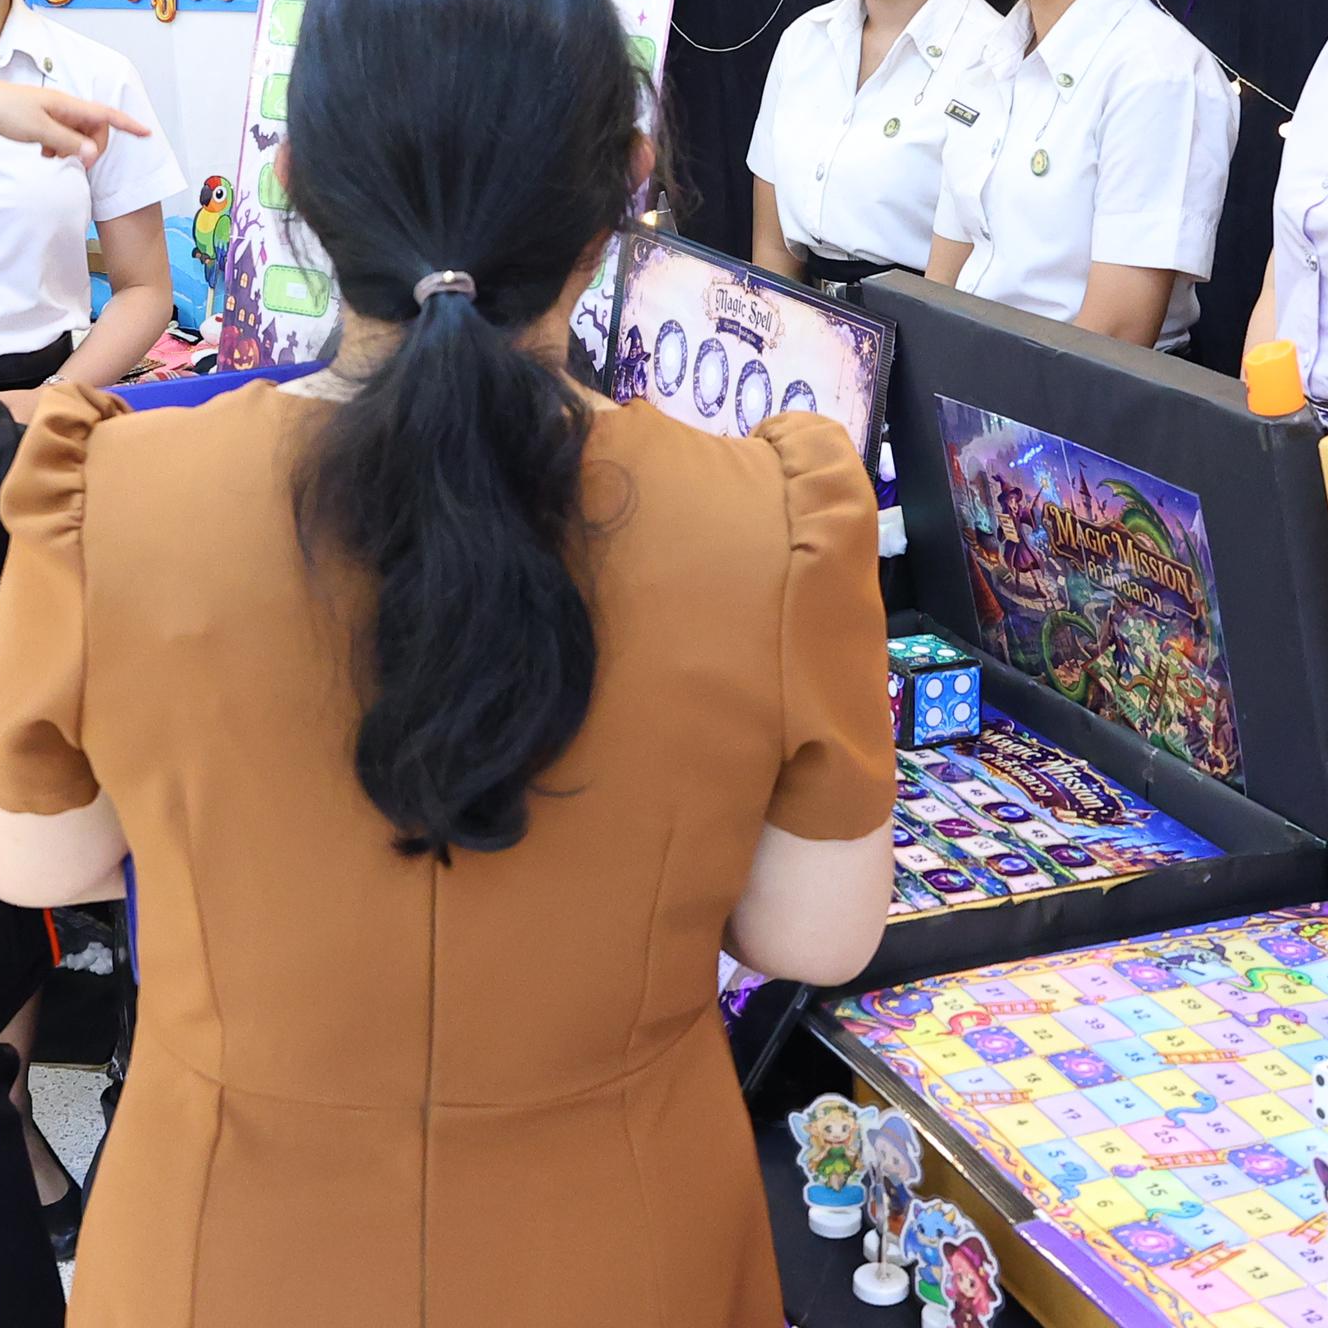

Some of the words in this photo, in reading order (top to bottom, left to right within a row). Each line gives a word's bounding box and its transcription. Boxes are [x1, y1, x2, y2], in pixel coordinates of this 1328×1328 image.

[715, 288, 747, 318] Magic
[748, 300, 773, 332] Spell
[1050, 506, 1113, 559] MAGIC
[1112, 531, 1194, 602] MISSION
[980, 728, 1043, 761] Magic
[1033, 756, 1105, 809] Mission
